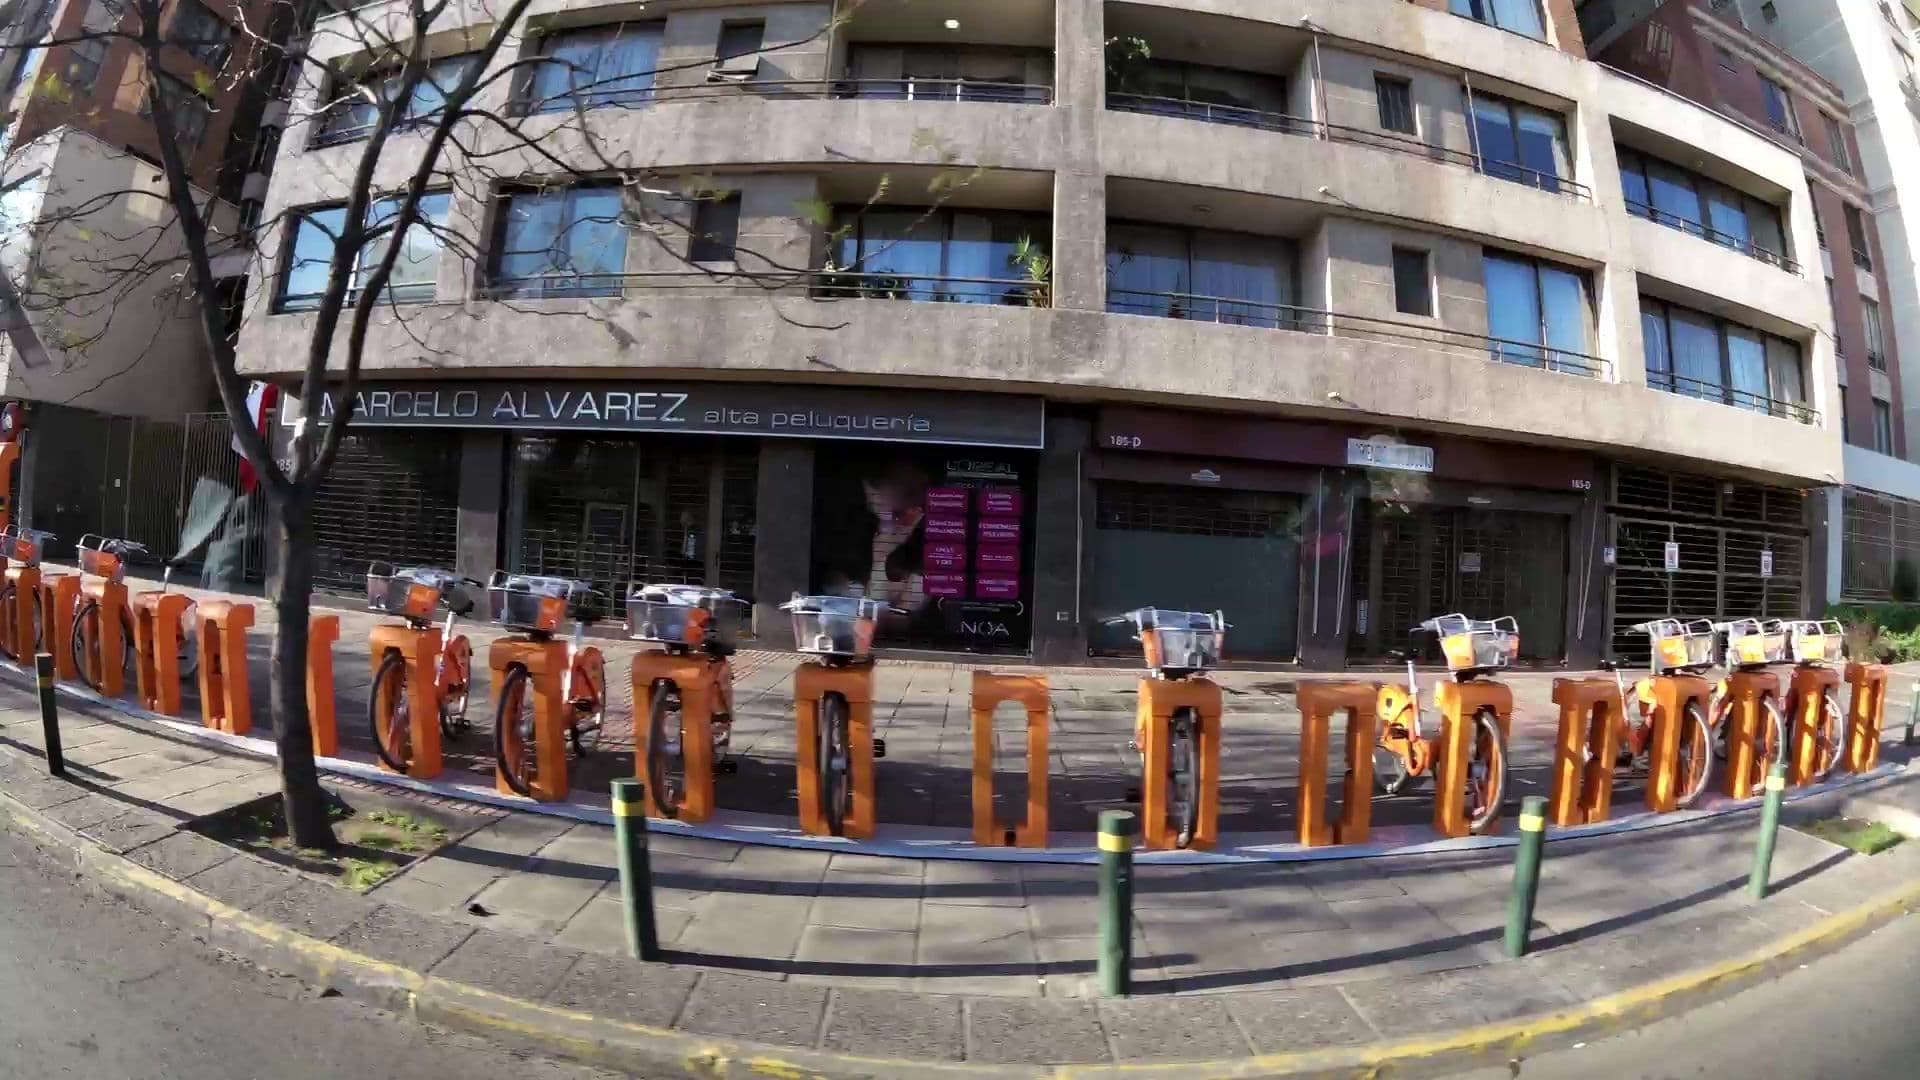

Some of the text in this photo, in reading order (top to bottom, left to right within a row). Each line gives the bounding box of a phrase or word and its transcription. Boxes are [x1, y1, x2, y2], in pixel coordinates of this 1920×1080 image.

[492, 391, 689, 422] ALVAREZ
[704, 407, 930, 432] alta peluquería
[960, 619, 1010, 636] NOA
